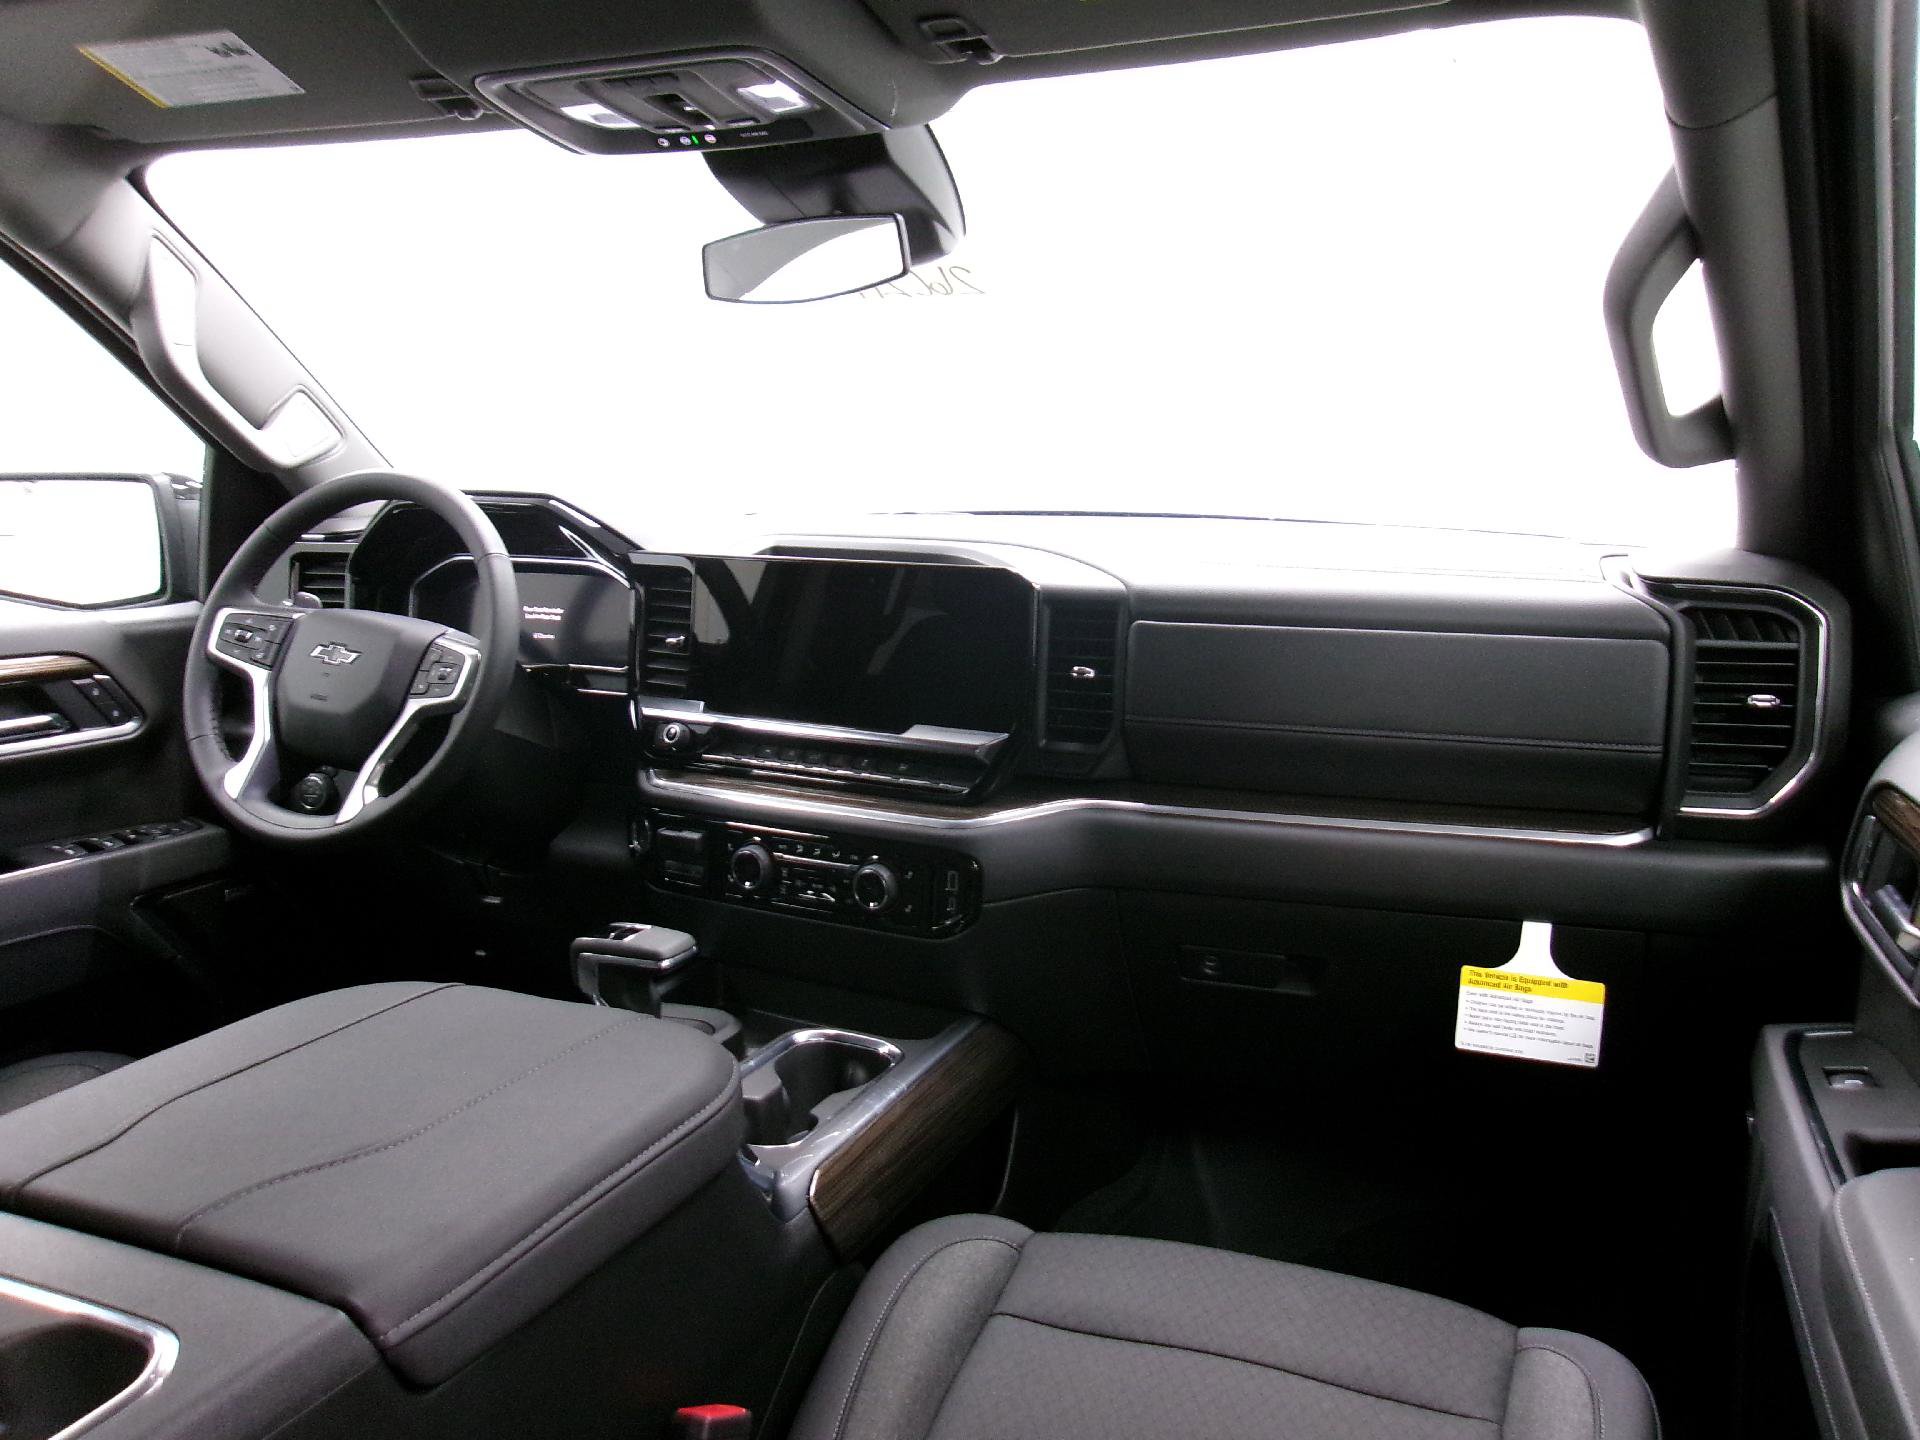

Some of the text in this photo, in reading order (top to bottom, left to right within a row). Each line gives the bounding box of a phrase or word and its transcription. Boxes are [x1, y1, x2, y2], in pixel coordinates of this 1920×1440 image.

[1468, 978, 1532, 993] Advanced Air Bags
[1469, 969, 1482, 978] This
[1485, 971, 1508, 981] Vehicle
[1519, 976, 1551, 987] Equipped
[1553, 980, 1568, 989] with
